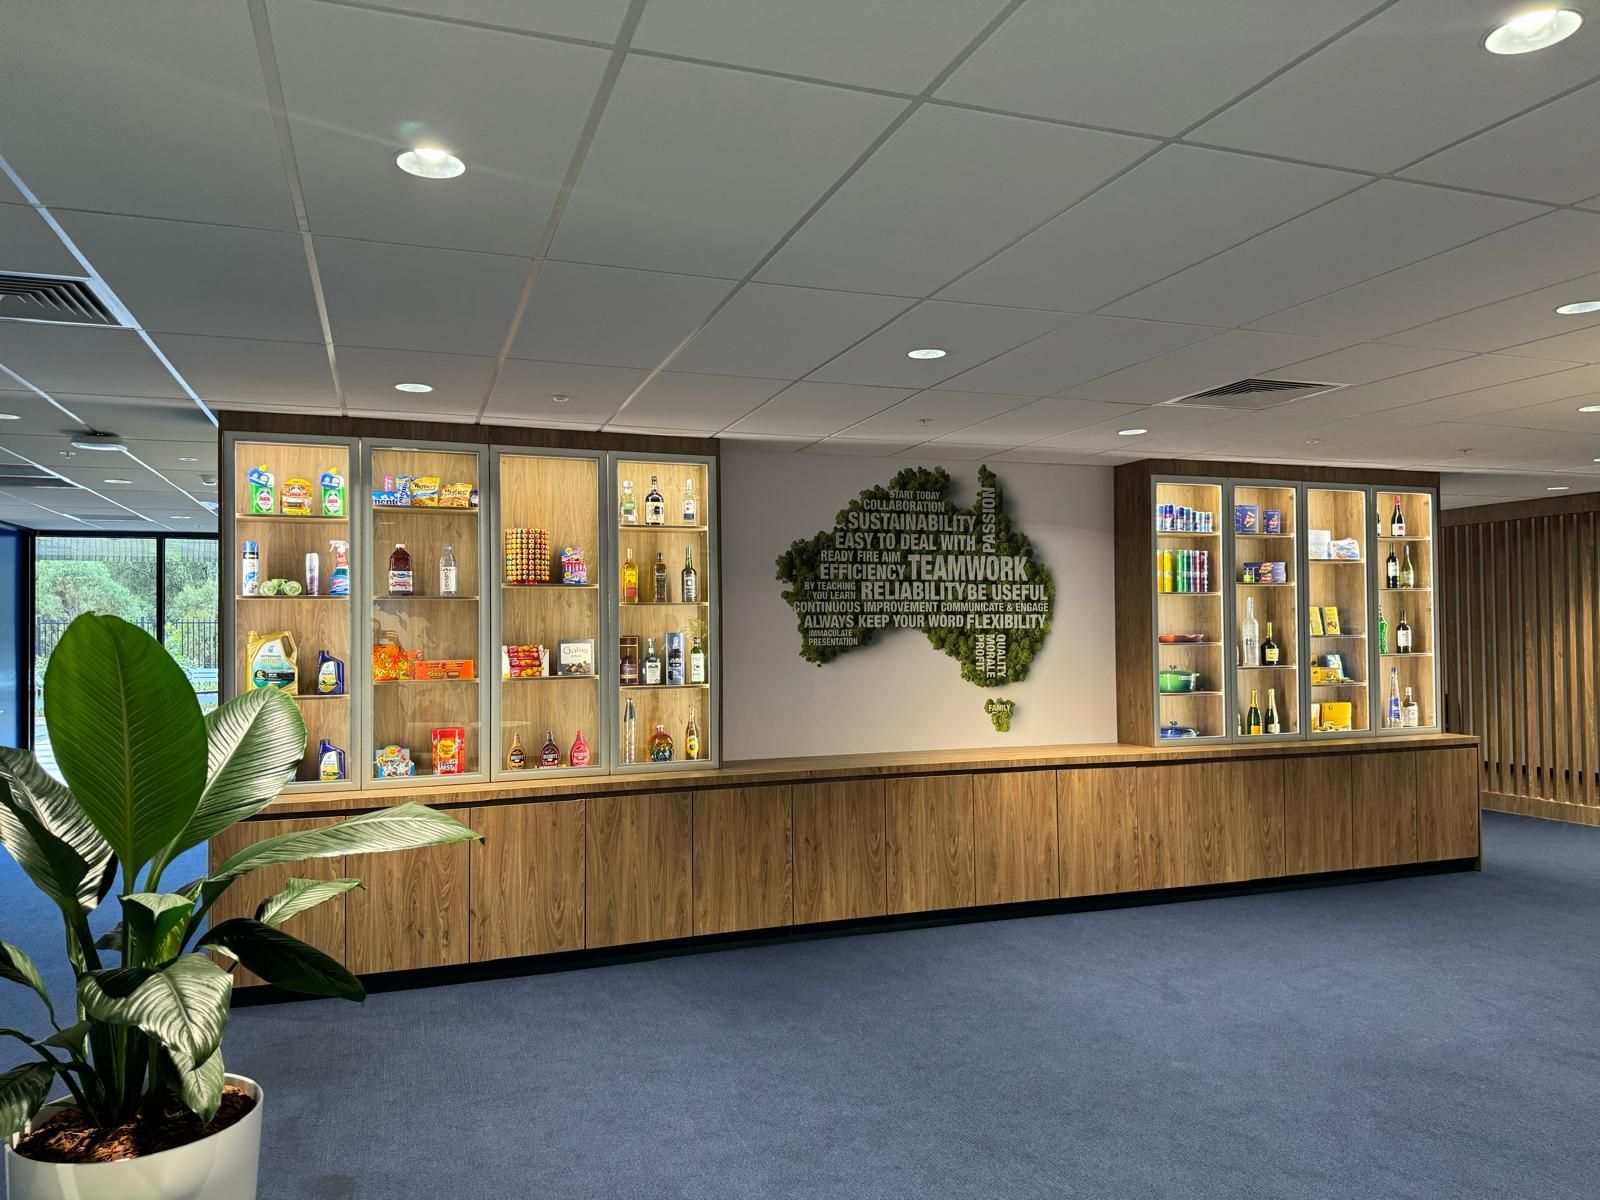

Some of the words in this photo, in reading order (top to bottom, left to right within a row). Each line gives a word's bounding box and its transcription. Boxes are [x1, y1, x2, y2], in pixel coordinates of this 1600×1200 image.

[889, 490, 913, 499] START
[916, 491, 940, 500] TODAY
[863, 500, 945, 513] COLLABORATION
[848, 512, 976, 532] SUSTAINABILITY
[982, 487, 996, 553] PASSION
[835, 532, 875, 549] EASY
[878, 533, 896, 550] TO
[901, 534, 937, 550] DEAL
[940, 534, 976, 551] WITH
[820, 550, 853, 562] READY
[857, 551, 880, 562] FIRE
[882, 551, 901, 563] AIM
[820, 564, 906, 580] EFFICIENCY
[908, 554, 1028, 581] TEAMWORK
[804, 582, 815, 590] BY
[817, 582, 856, 591] TEACHING
[861, 581, 966, 600] RELIABILITY
[967, 584, 987, 600] BE
[991, 584, 1049, 600] USEFUL
[812, 591, 828, 600] YOU
[830, 591, 856, 600] LEARN
[793, 601, 861, 613] CONTINUOUS
[863, 601, 938, 613] IMPROVEMENT
[942, 602, 1004, 612] COMMUNICATE
[1006, 602, 1013, 612] &
[1016, 602, 1049, 612] ENGAGE
[804, 614, 854, 628] ALWAYS
[858, 614, 889, 628] KEEP
[892, 614, 925, 628] YOUR
[928, 614, 964, 628] WORD
[966, 614, 1046, 629] FLEXIBILITY
[808, 629, 852, 637] IMMACULATE
[808, 637, 858, 646] PRESENTATION
[975, 634, 985, 672] PROFIT
[986, 634, 996, 678] MORALE
[996, 634, 1006, 677] QUALITY
[988, 704, 1011, 712] FAMILY
